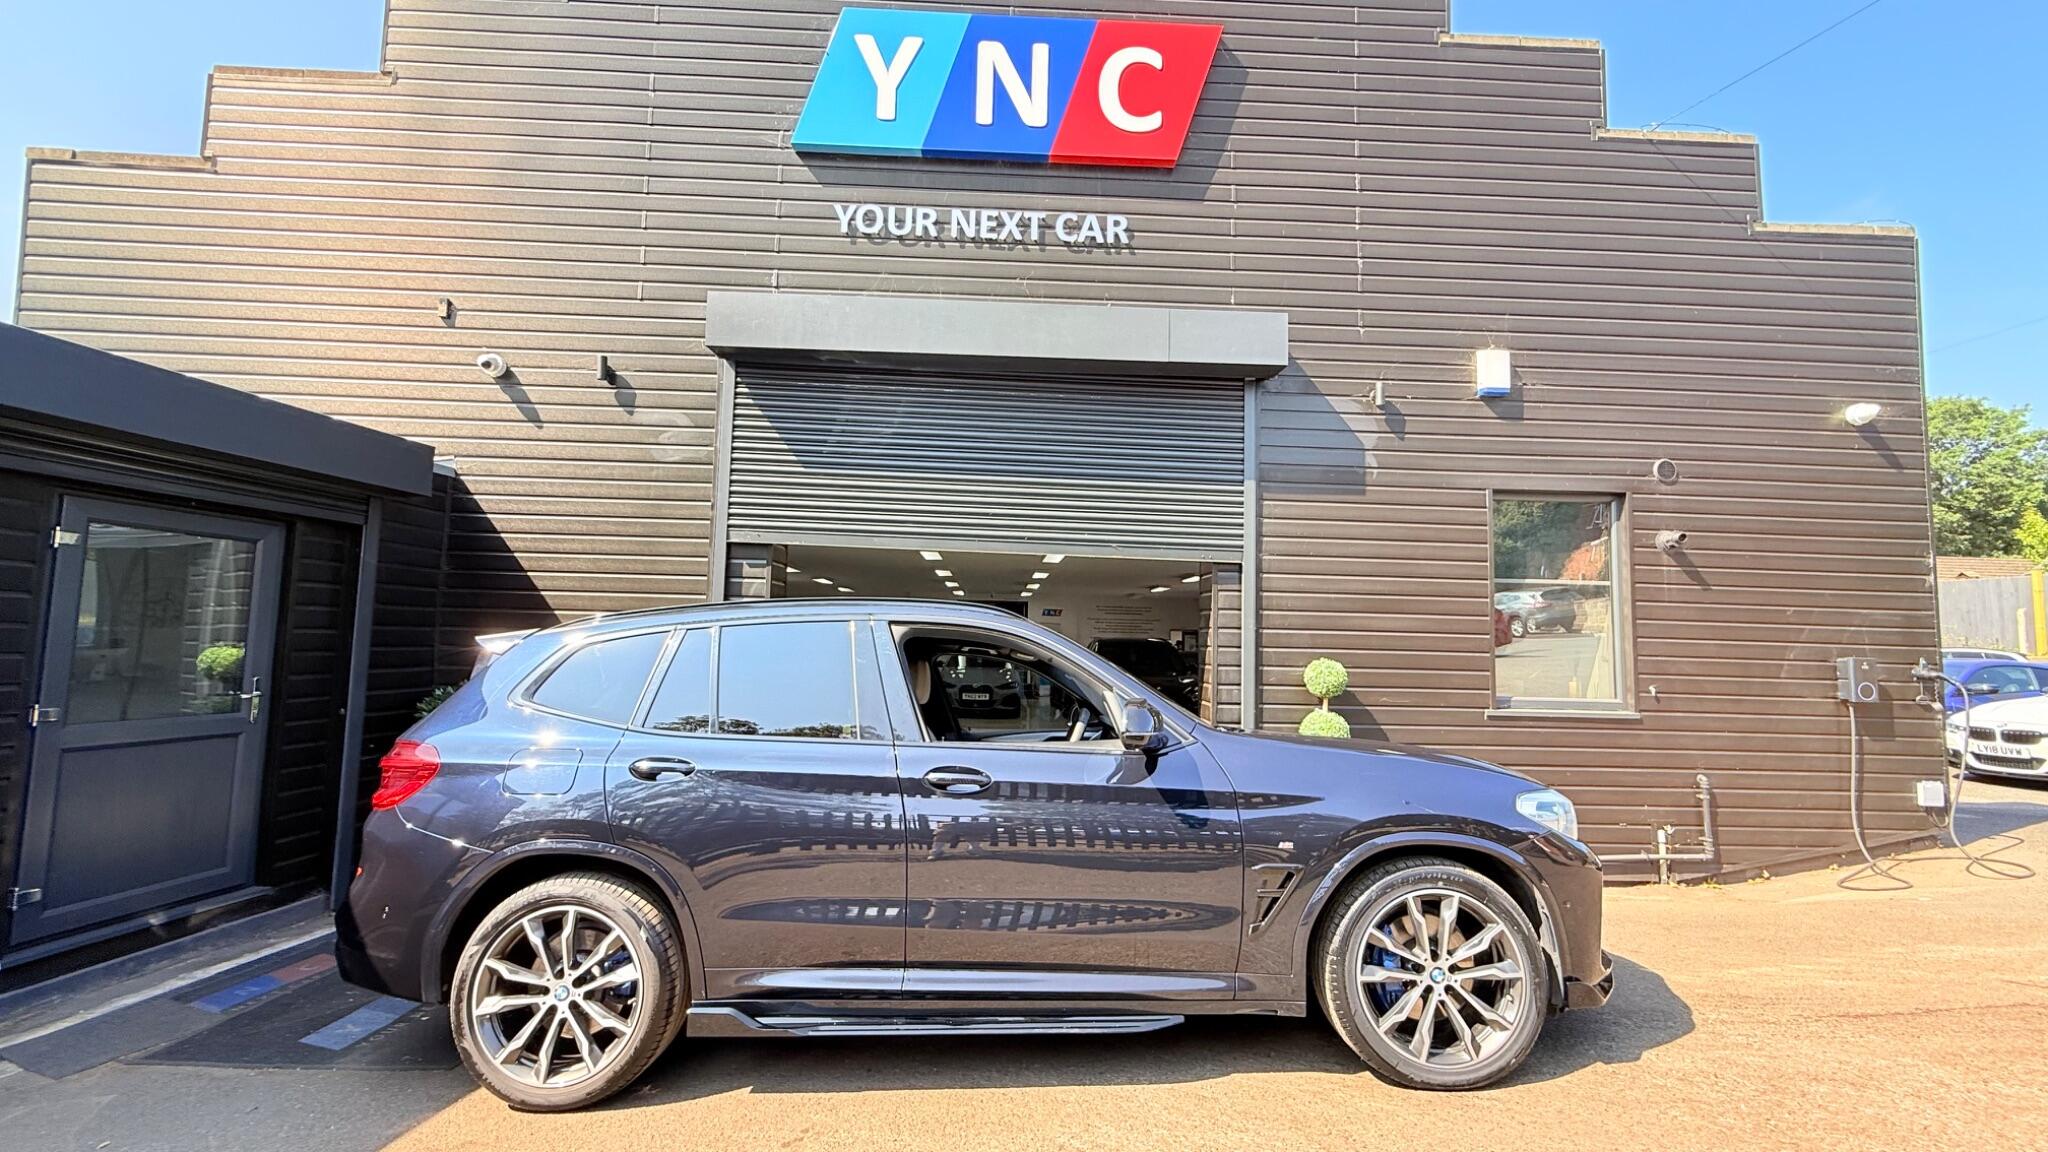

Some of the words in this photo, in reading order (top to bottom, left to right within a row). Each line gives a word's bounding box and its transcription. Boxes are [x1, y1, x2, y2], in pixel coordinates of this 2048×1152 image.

[853, 34, 1163, 133] YNC
[833, 203, 939, 237] YOUR
[950, 208, 1044, 242] NEXT
[1055, 211, 1129, 244] CAR
